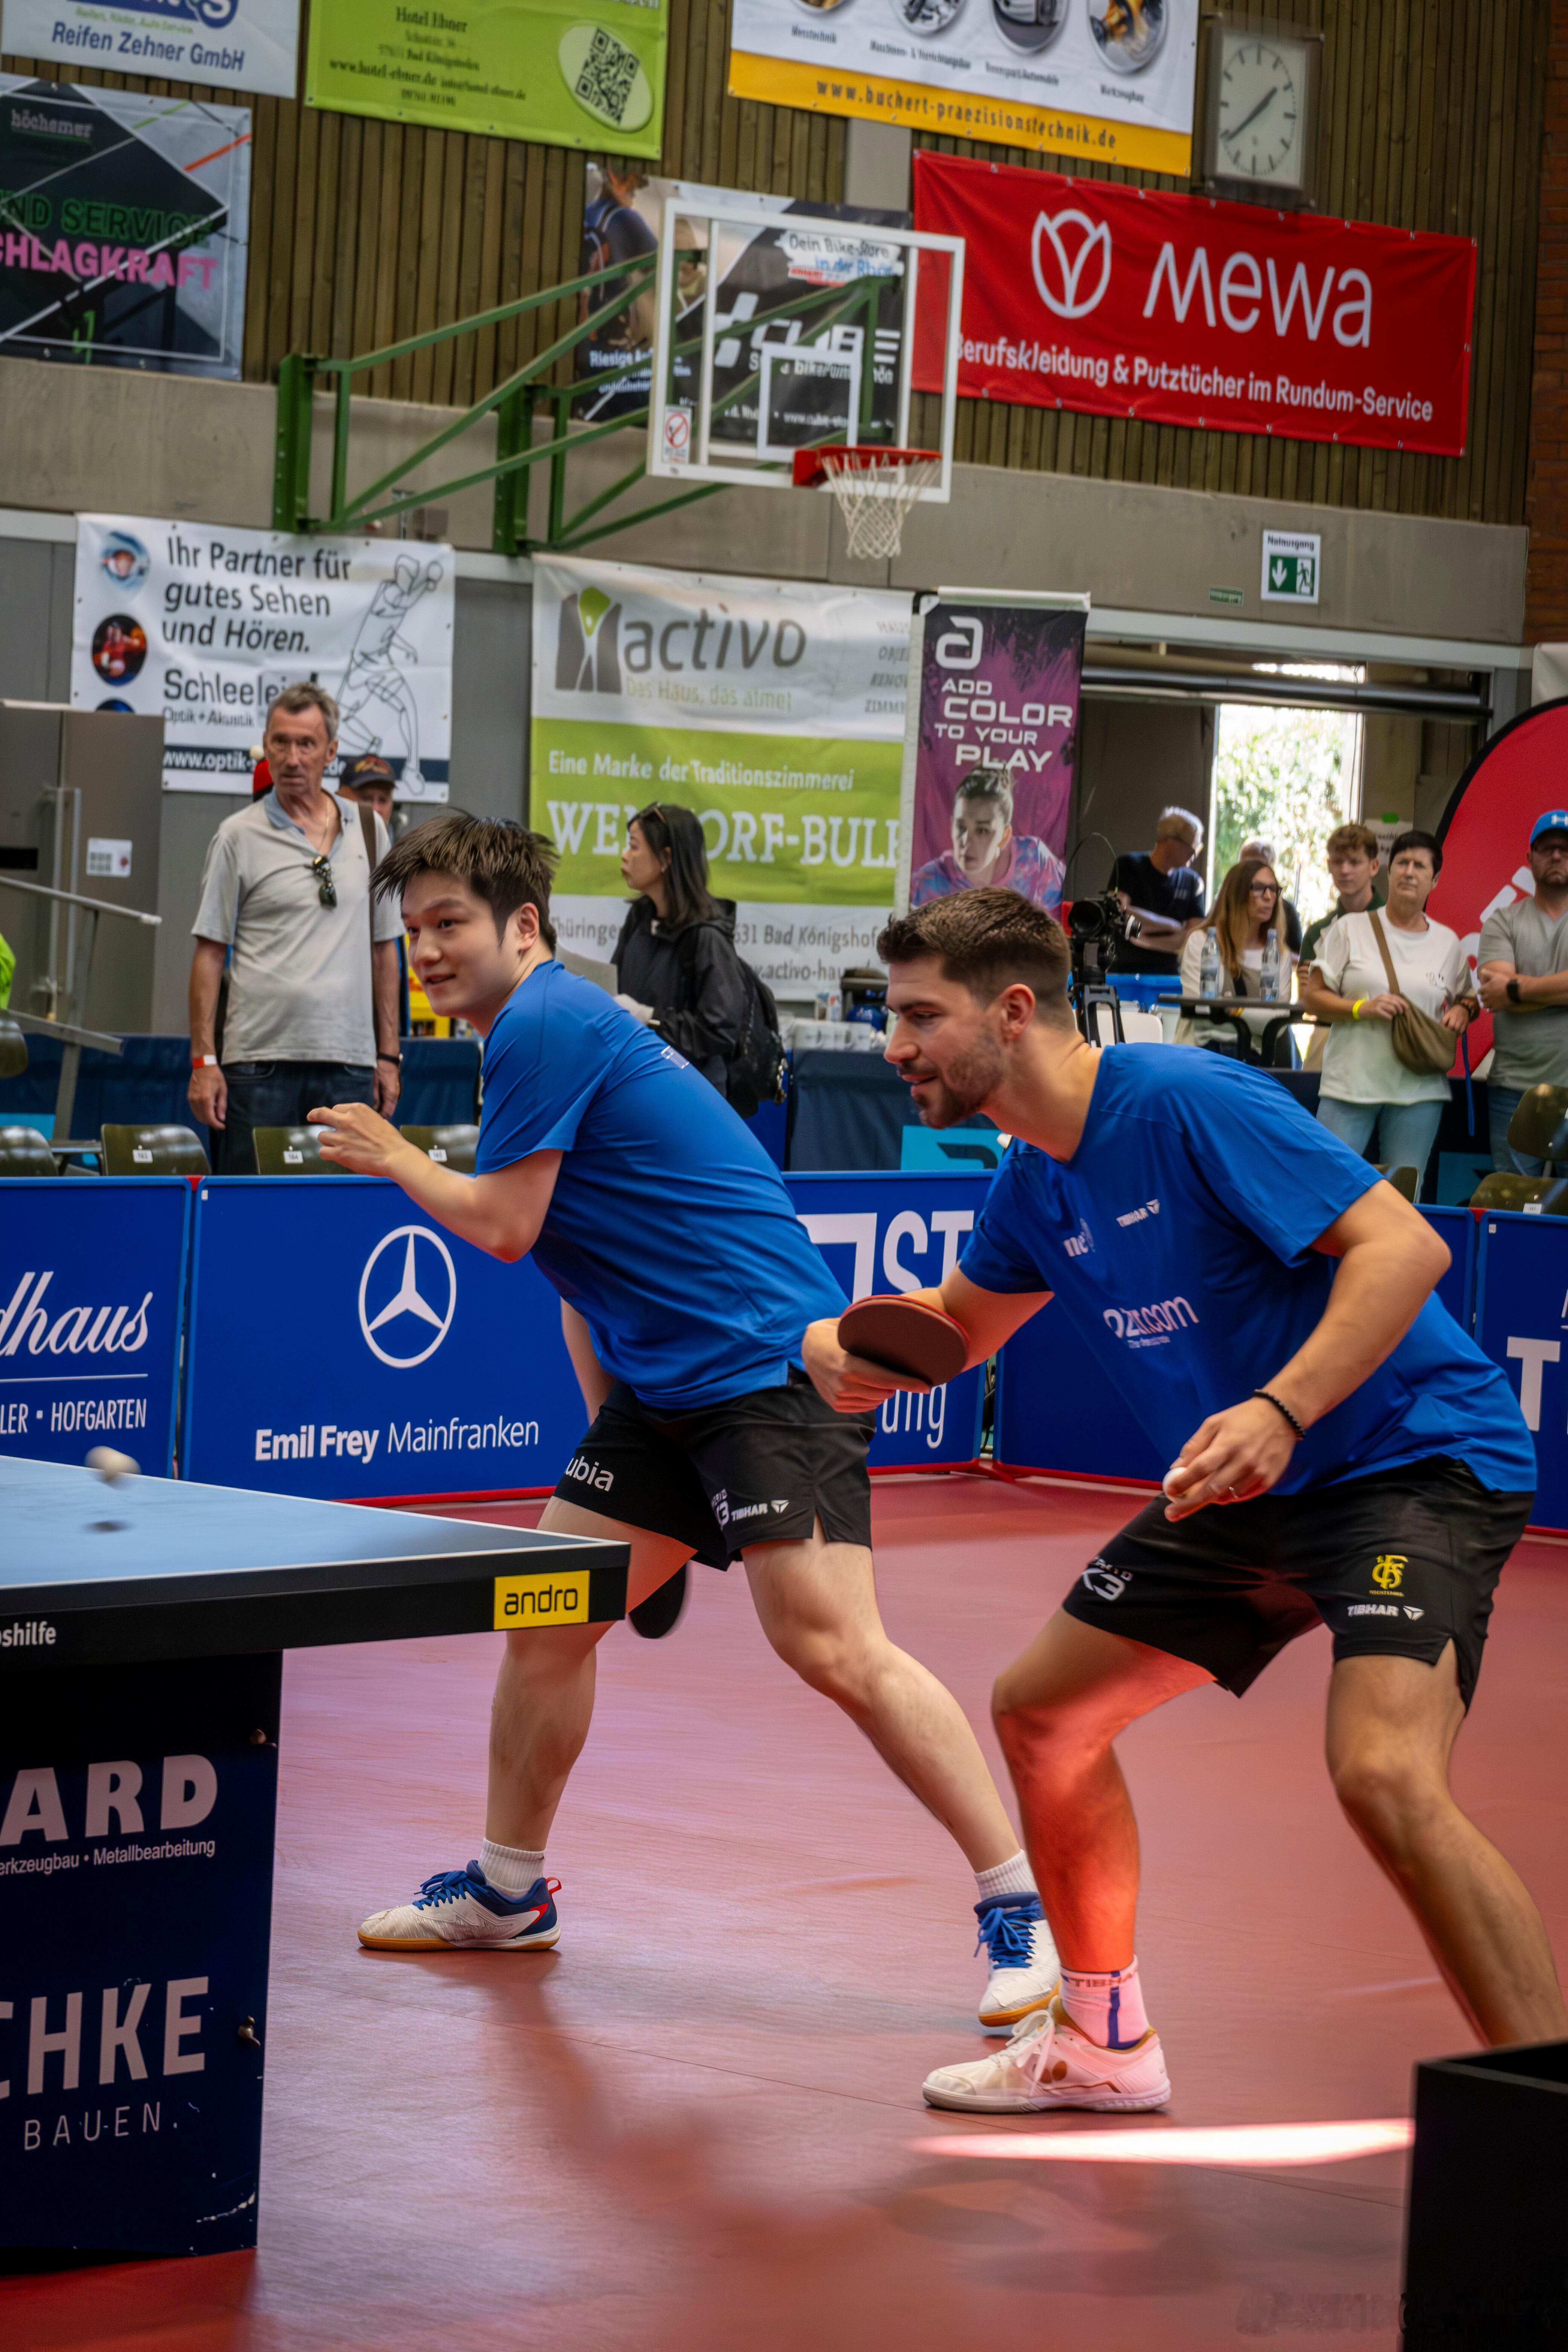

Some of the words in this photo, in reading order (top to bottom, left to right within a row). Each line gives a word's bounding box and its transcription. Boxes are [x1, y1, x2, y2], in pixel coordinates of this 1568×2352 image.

[52, 21, 112, 51] Reifen
[118, 31, 186, 62] Zehner
[190, 42, 245, 72] GmbH
[816, 80, 1116, 149] www.buchert-praezisionstechnik.de
[0, 190, 51, 230] ND
[0, 232, 218, 290] HLAGKRAFT
[1113, 354, 1130, 385] &
[1133, 356, 1246, 399] Putztücher
[1248, 373, 1272, 403] im
[1276, 375, 1433, 421] Rundum-Service
[167, 536, 201, 568] Ihr
[210, 542, 304, 578] Partner
[314, 548, 351, 581] für
[1268, 533, 1314, 551] Notausgang
[164, 581, 242, 612] gutes
[250, 584, 331, 617] Sehen
[162, 617, 214, 648] und
[226, 620, 311, 654] Hören.
[624, 602, 807, 673] activo
[626, 676, 653, 700] Das
[658, 679, 704, 706] Haus,
[710, 678, 738, 706] das
[744, 685, 793, 712] atmet
[941, 678, 993, 695] ADD
[164, 706, 196, 724] Optik
[943, 697, 1073, 728] COLOR
[934, 723, 965, 740] TO
[975, 726, 1038, 746] YOUR
[549, 750, 588, 776] Eine
[593, 753, 653, 781] Marke
[658, 755, 689, 783] der
[690, 760, 855, 792] Traditionszimmerei
[955, 744, 1053, 772] PLAY
[764, 924, 792, 946] Bad
[798, 925, 879, 954] Königshof
[0, 1403, 28, 1434] LER
[51, 1398, 147, 1432] HOFGARTEN
[882, 1383, 946, 1449] ung
[255, 1425, 315, 1461] Emil
[320, 1425, 380, 1464] Frey
[387, 1415, 539, 1454] Mainfranken
[565, 1456, 614, 1492] ubia
[504, 1584, 579, 1618] andro
[1347, 1603, 1400, 1617] TIBHAR
[0, 1620, 56, 1647] shilfe
[0, 1852, 79, 1876] erkzeugbau
[93, 1839, 216, 1866] Metallbearbeitung
[0, 1976, 209, 2100] HKE
